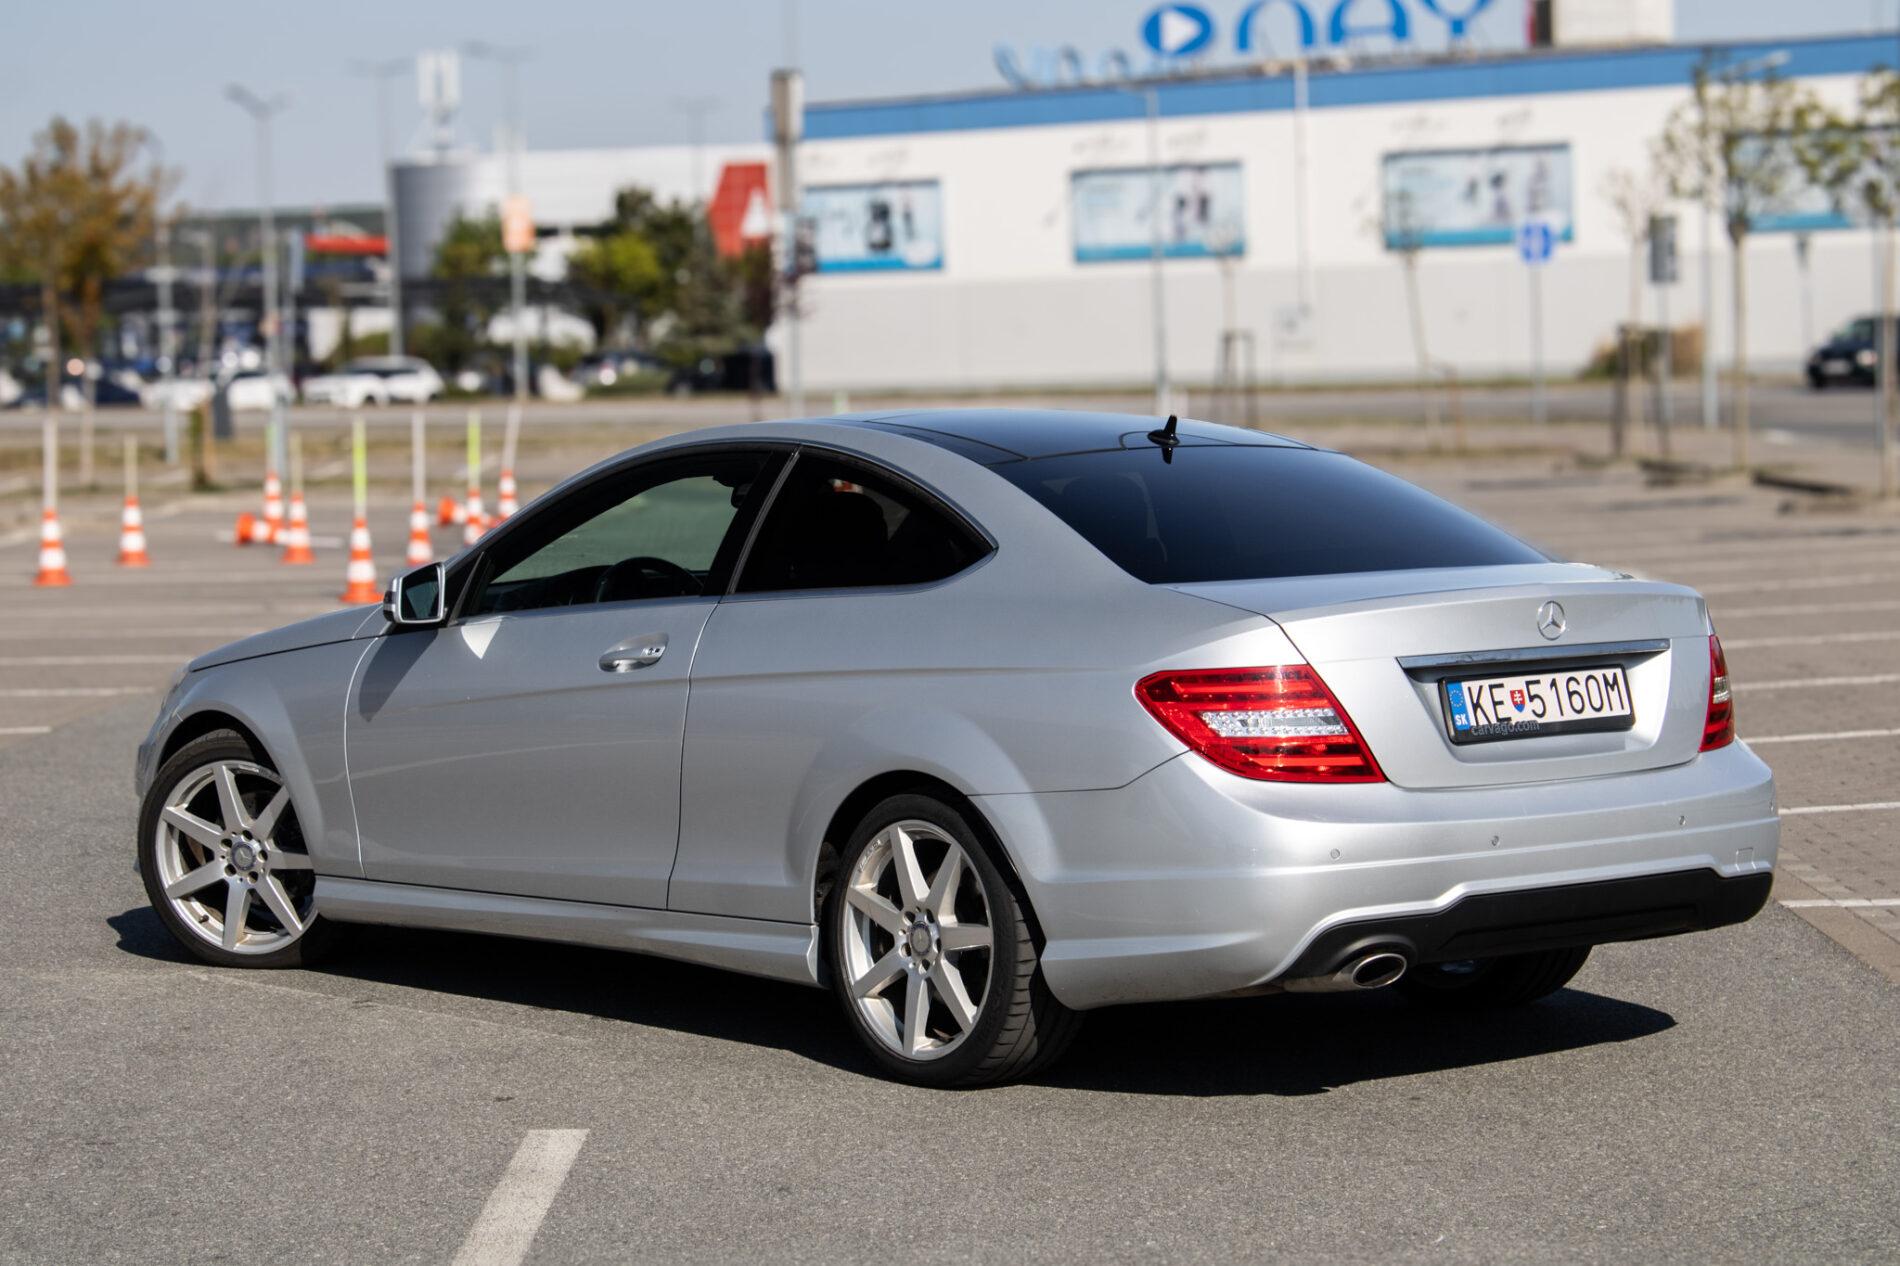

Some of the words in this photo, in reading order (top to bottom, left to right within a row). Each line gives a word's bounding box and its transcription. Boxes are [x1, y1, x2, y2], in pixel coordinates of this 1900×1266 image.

[1468, 683, 1511, 726] KE
[1455, 713, 1468, 726] SK
[1471, 720, 1540, 736] carvago.com
